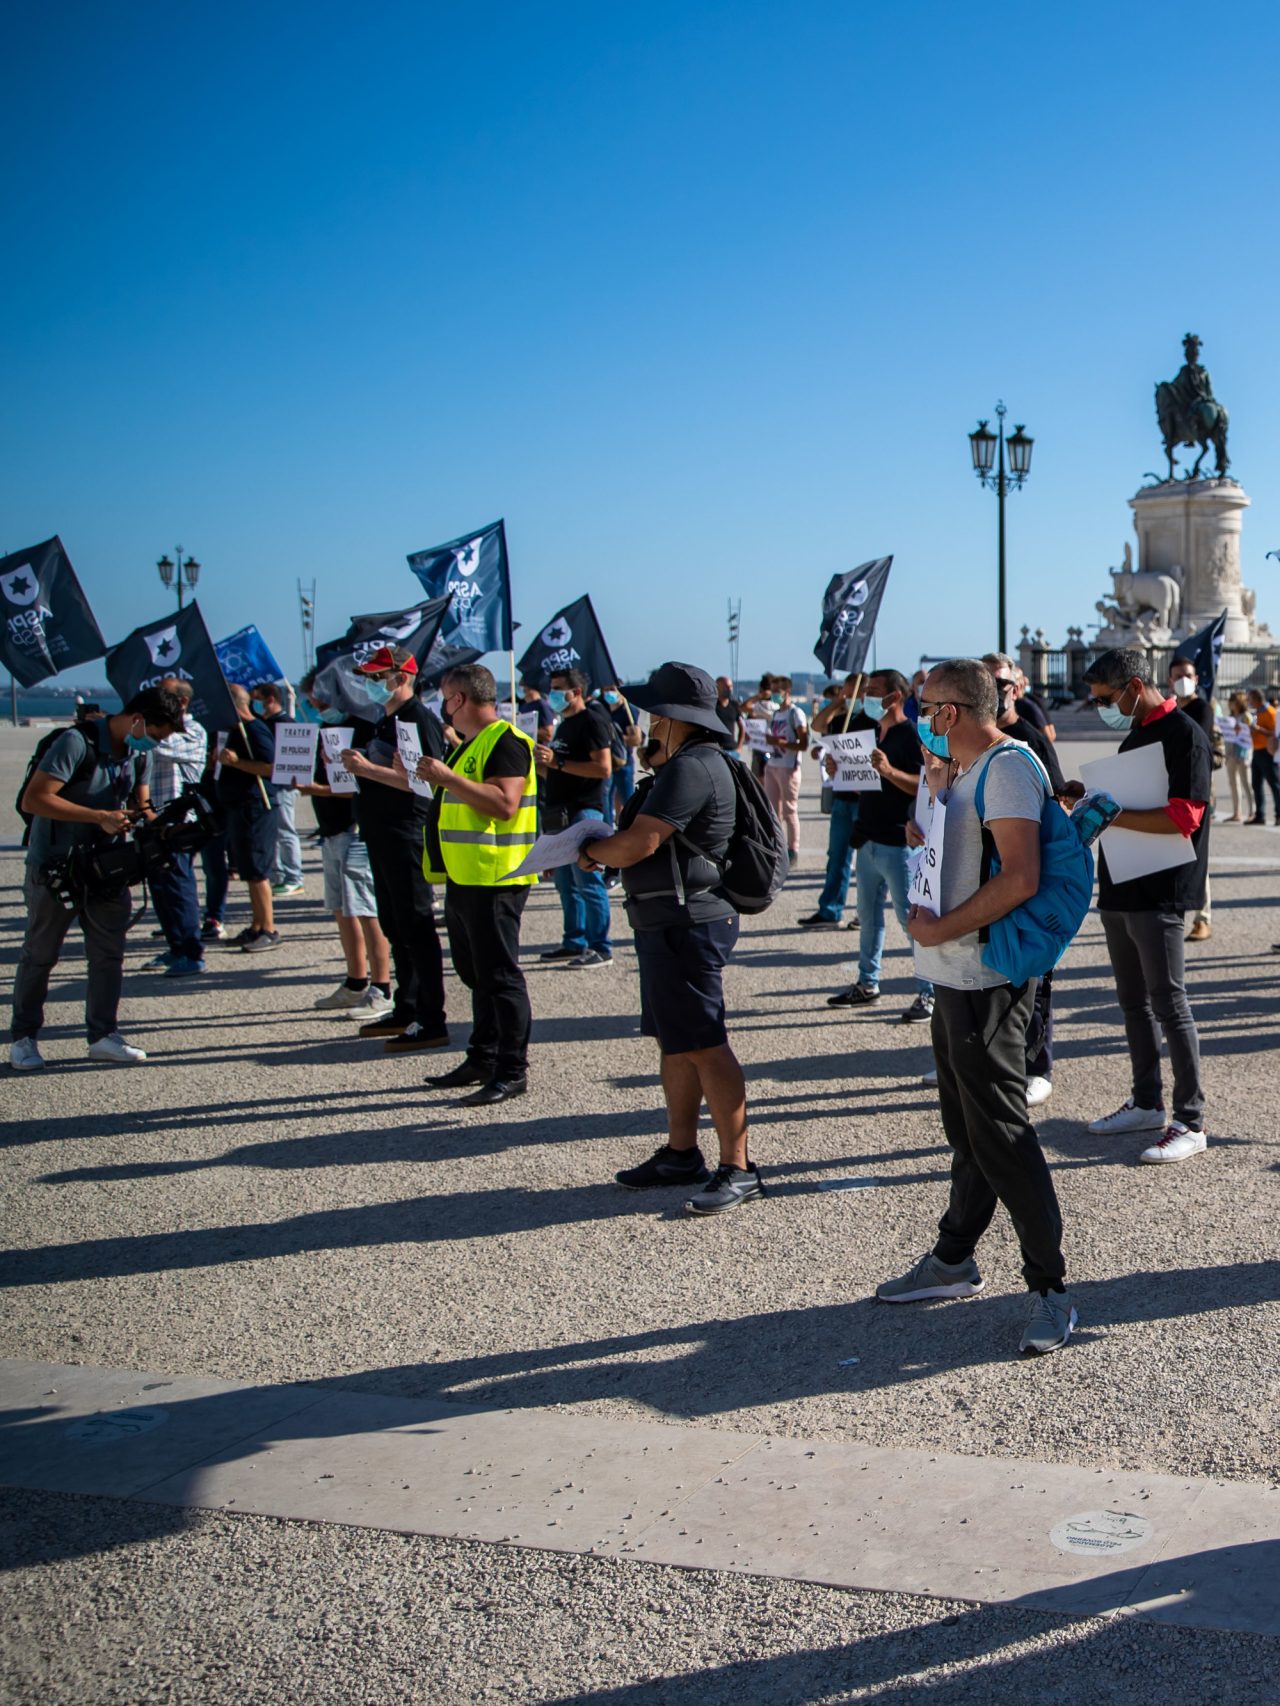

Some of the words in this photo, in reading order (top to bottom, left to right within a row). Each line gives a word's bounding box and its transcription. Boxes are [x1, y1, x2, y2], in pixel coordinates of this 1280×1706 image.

[284, 728, 311, 736] TRATEM
[832, 740, 839, 750] A
[839, 738, 863, 750] VIDA
[842, 770, 879, 782] IMPORTA
